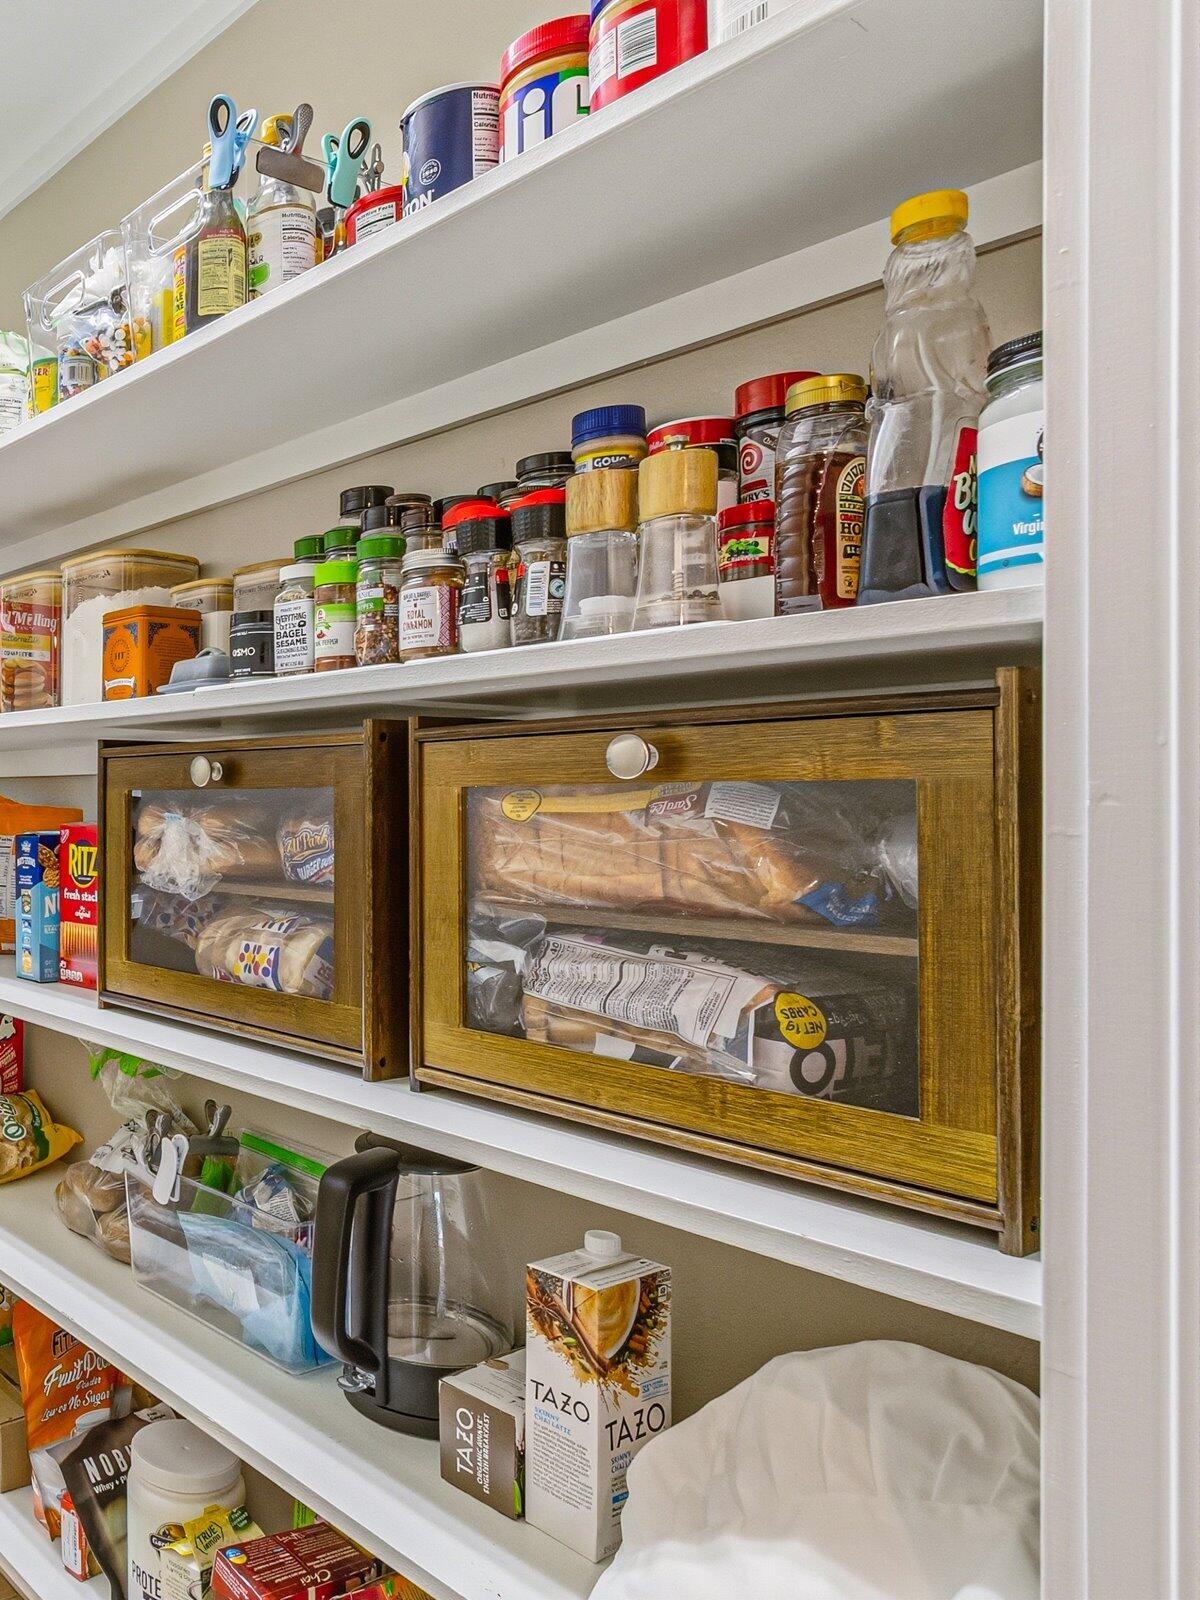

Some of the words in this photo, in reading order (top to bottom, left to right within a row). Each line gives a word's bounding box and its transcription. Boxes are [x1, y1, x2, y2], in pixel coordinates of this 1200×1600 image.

[407, 609, 426, 620] ROYAL
[276, 629, 307, 640] BAGEL
[276, 638, 307, 648] SESAME
[68, 842, 99, 877] RITZ
[63, 888, 80, 901] fresh
[779, 1005, 818, 1020] CARBS
[804, 1019, 825, 1036] NET
[43, 1358, 84, 1396] Fruit
[67, 1394, 81, 1411] No
[82, 1390, 111, 1408] Sugar
[529, 1378, 590, 1424] TAZO
[534, 1406, 560, 1421] SKINNY
[534, 1413, 552, 1427] CHAI
[552, 1421, 572, 1437] LATTE
[604, 1402, 666, 1451] TAZO
[455, 1407, 475, 1475] TAZO
[482, 1412, 490, 1460] BREAKFAST
[476, 1447, 484, 1485] ORGANIC
[611, 1451, 631, 1465] SKINNY
[482, 1460, 490, 1495] ENGLISH
[93, 1480, 115, 1495] Whey
[195, 1524, 219, 1543] TRUE
[299, 1568, 332, 1586] Chai
